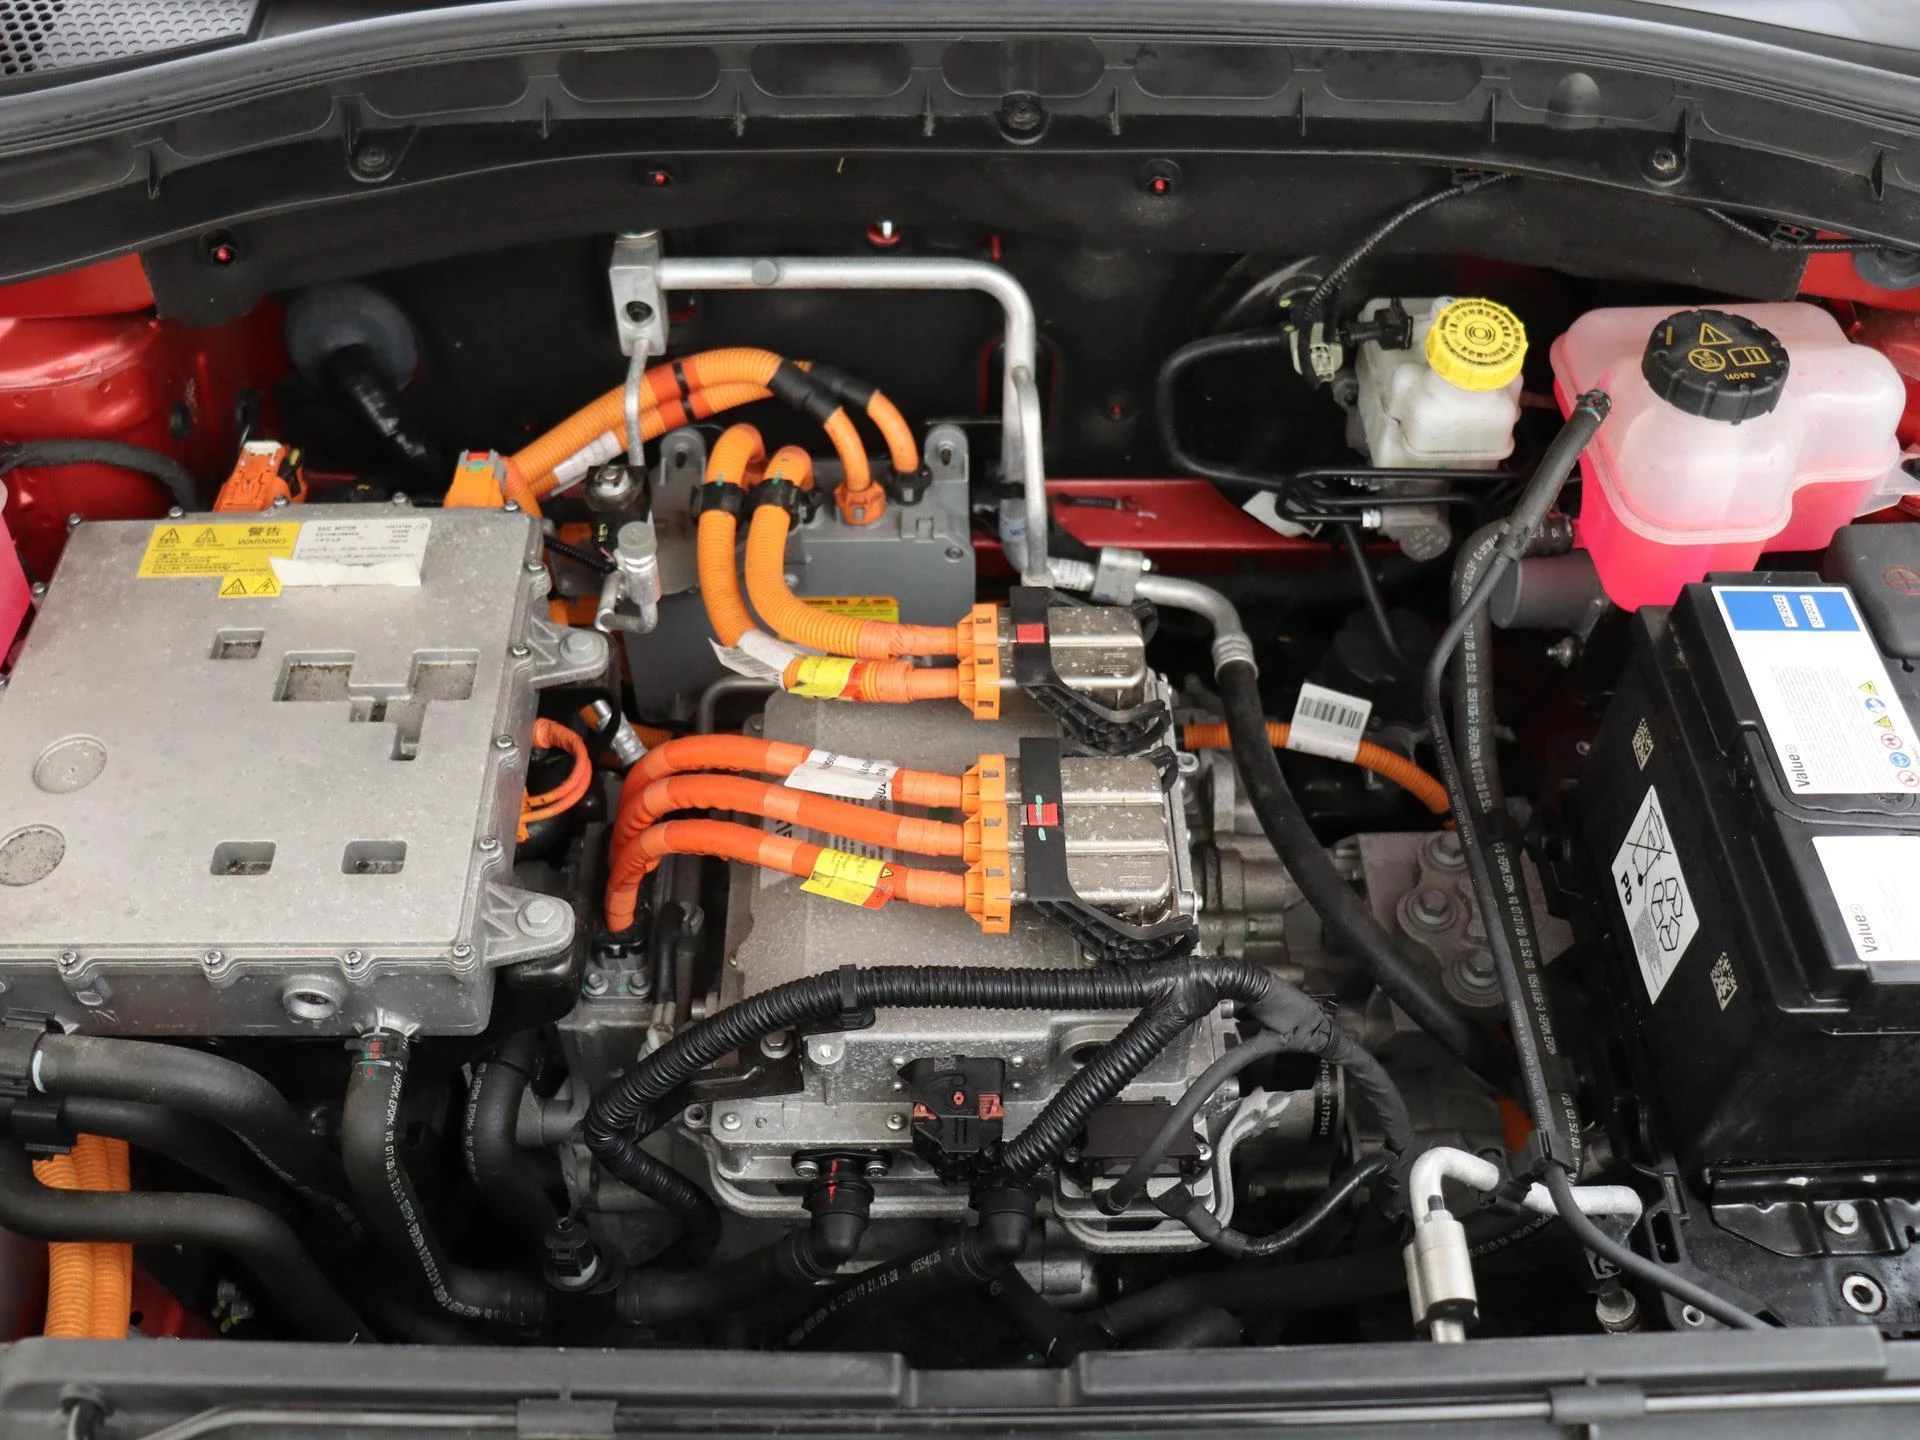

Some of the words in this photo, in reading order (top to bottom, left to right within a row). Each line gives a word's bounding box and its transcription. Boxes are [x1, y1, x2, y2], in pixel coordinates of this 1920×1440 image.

[1788, 753, 1811, 788] Value
[1620, 869, 1633, 906] Pb
[1854, 914, 1879, 954] Value
[1565, 1108, 1581, 1149] 03:52:03
